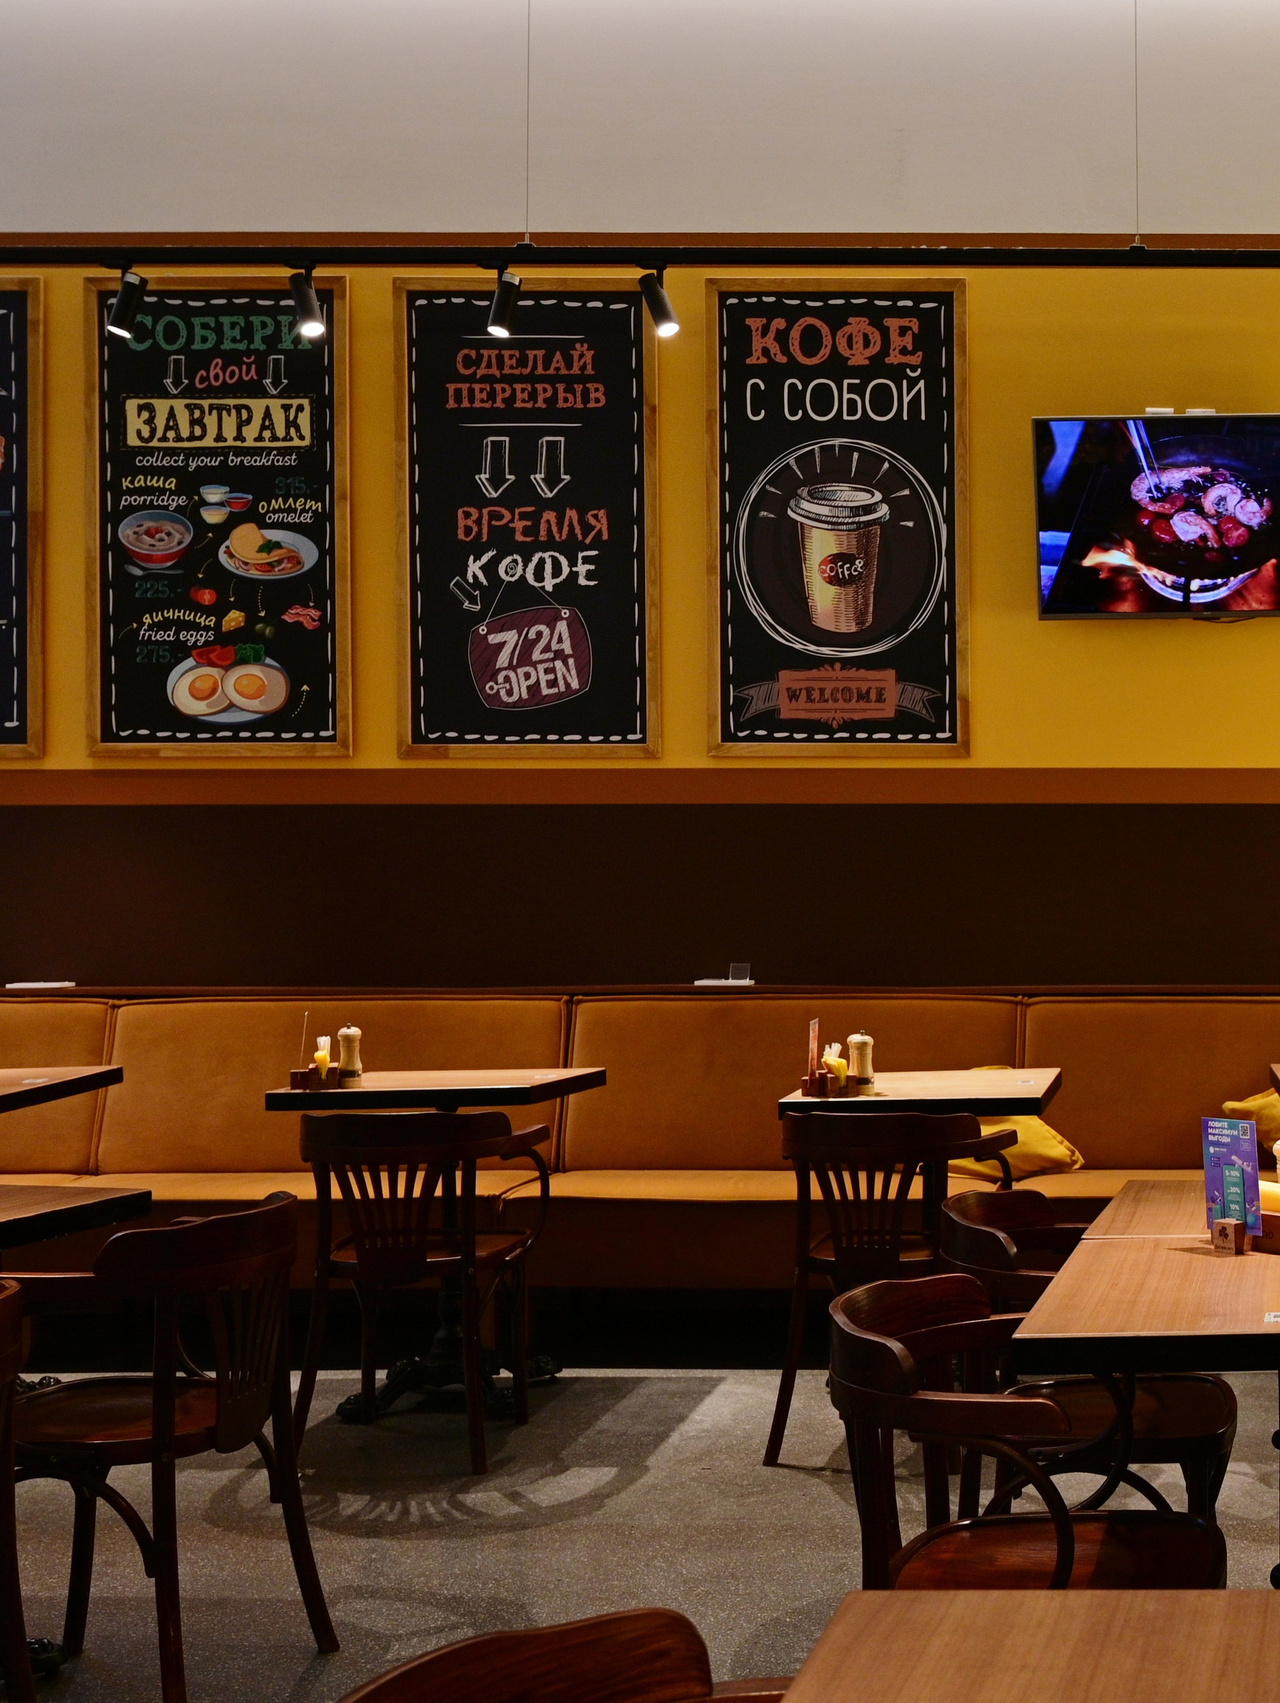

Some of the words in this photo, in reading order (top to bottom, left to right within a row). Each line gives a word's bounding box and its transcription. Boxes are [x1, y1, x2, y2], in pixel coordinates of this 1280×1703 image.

[745, 316, 923, 366] КОФЕ
[194, 355, 259, 389] свой
[456, 342, 596, 379] СДЕЛАЙ
[445, 383, 607, 409] ПЕРЕРЫВ
[746, 378, 766, 421] С
[783, 367, 926, 421] СОБОЙ
[135, 402, 306, 444] ЗАВТРАК
[135, 450, 186, 467] collect
[188, 455, 223, 472] your
[228, 450, 298, 468] breakfast
[122, 475, 177, 491] каша
[119, 490, 188, 511] porridge
[258, 497, 322, 514] омлет
[265, 508, 314, 524] omelet
[457, 506, 609, 544] ВРЕМЯ
[466, 547, 599, 592] КОФЕ
[142, 608, 217, 629] яичница
[138, 627, 178, 644] fried
[179, 629, 216, 647] eggs
[487, 619, 573, 669] 7/24
[485, 657, 580, 703] OPEN
[785, 686, 886, 704] WELCOME
[1208, 1128, 1238, 1136] МАКСИМУМ
[1208, 1135, 1230, 1143] ВЫГОДЫ
